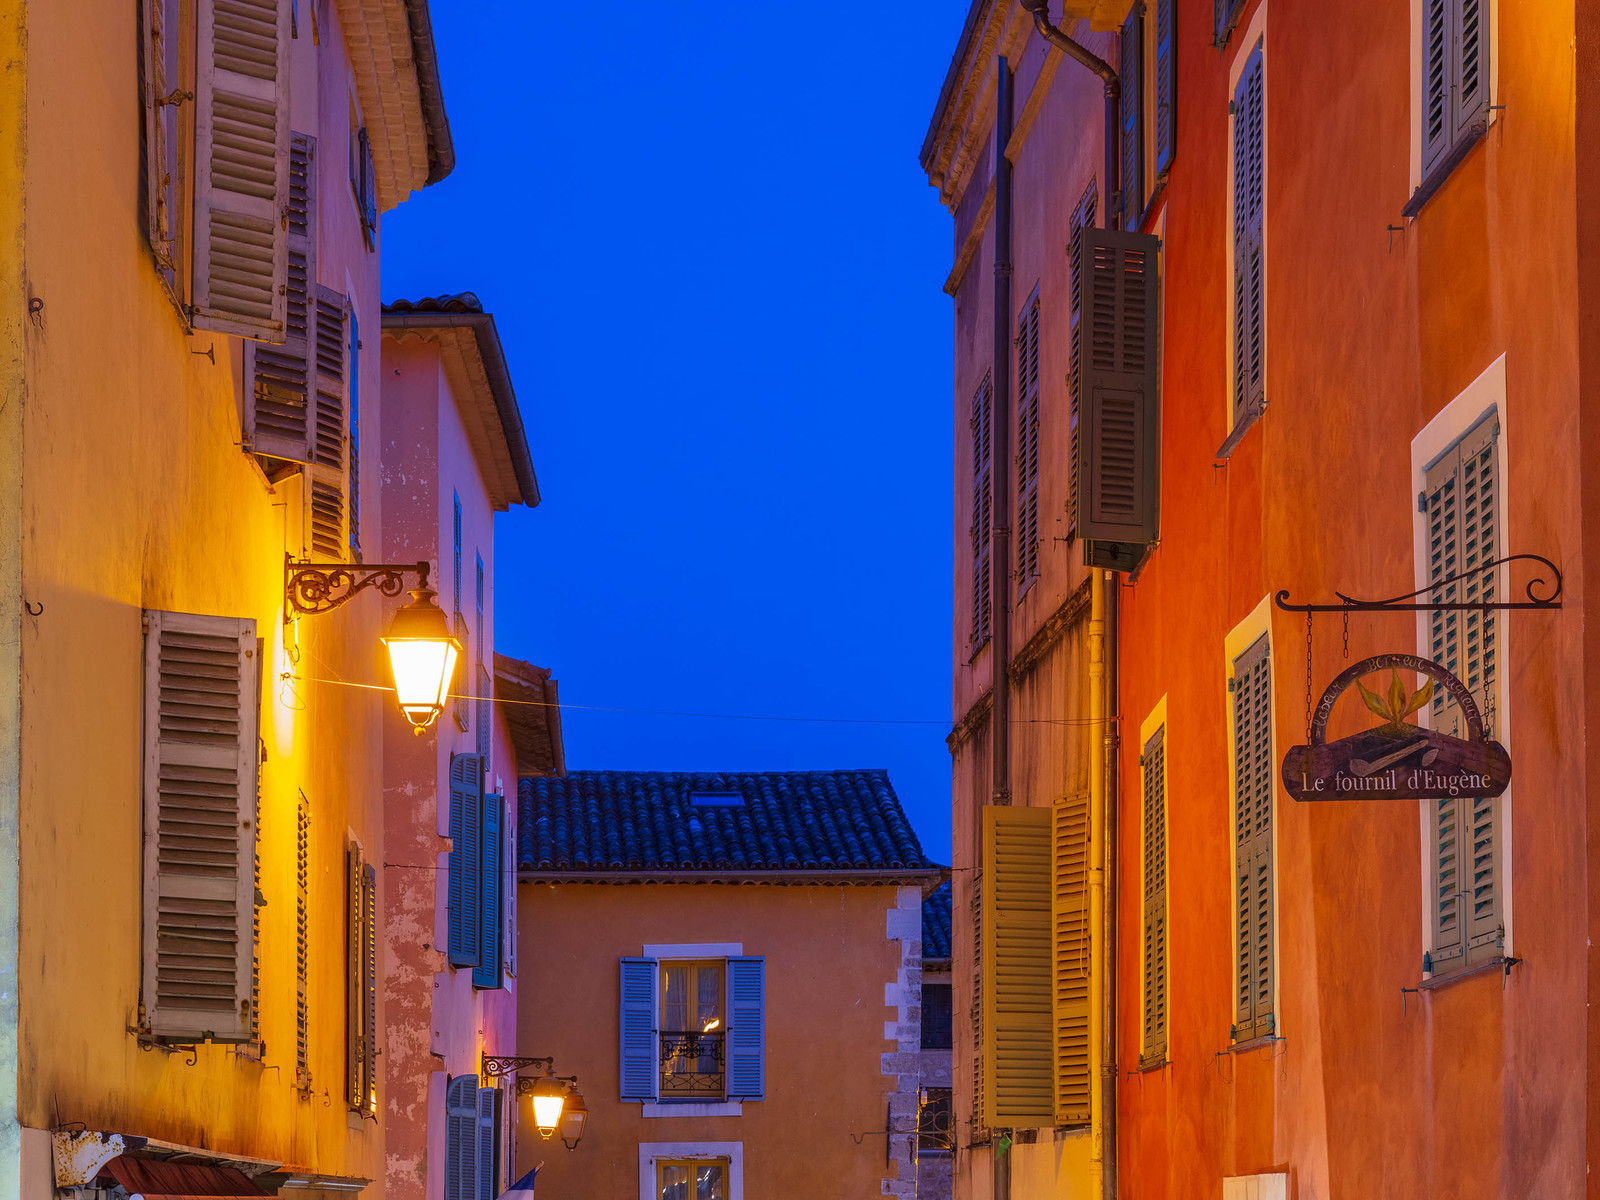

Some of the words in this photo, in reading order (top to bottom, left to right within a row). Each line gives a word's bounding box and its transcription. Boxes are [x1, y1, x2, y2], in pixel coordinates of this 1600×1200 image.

[1302, 772, 1324, 792] Le
[1335, 769, 1397, 791] fournil
[1407, 769, 1491, 795] d'Eugène
